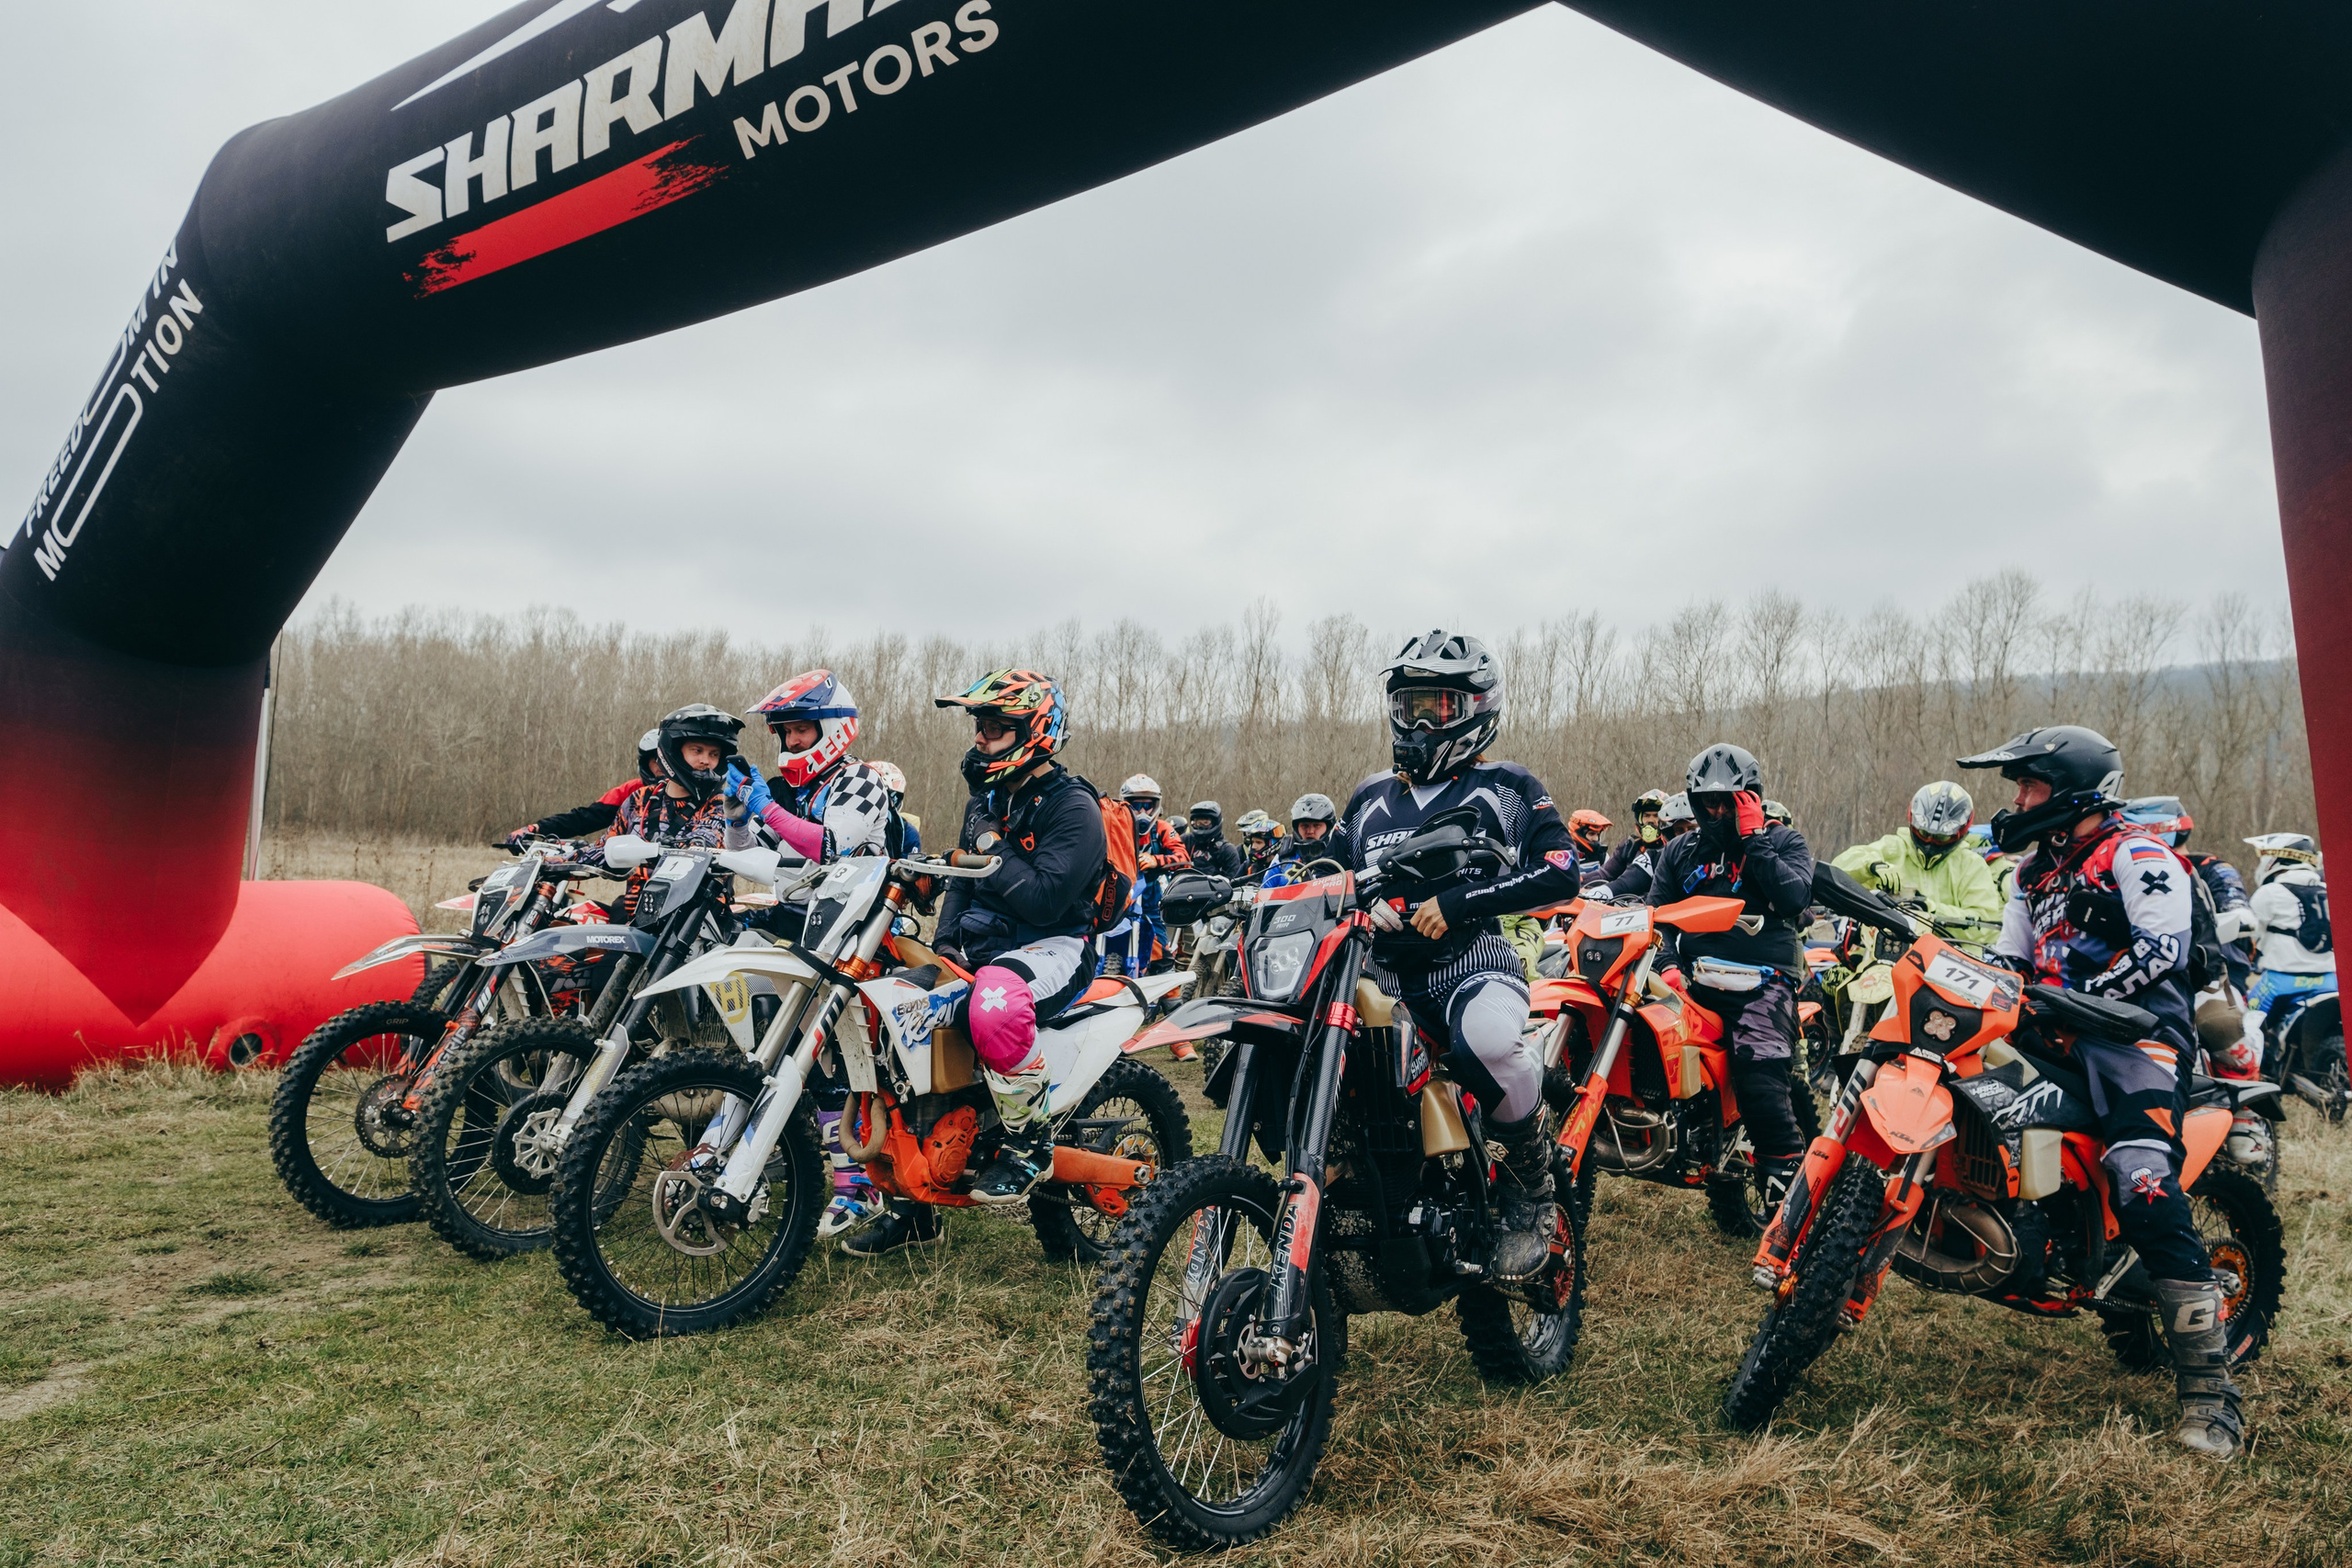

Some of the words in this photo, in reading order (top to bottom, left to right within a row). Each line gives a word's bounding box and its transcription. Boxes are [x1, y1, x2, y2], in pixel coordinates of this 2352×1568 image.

[733, 0, 999, 160] MOTORS
[34, 278, 203, 581] MOTION
[1322, 881, 1342, 889] PRO
[1273, 914, 1297, 925] 300
[1614, 915, 1635, 928] 77
[586, 935, 627, 944] MOTOREX
[2104, 934, 2180, 998] АЛАС
[1944, 966, 1980, 990] 171
[1889, 1131, 1916, 1145] KTM
[1811, 1149, 1830, 1160] KTM
[1270, 1202, 1299, 1292] KENDA
